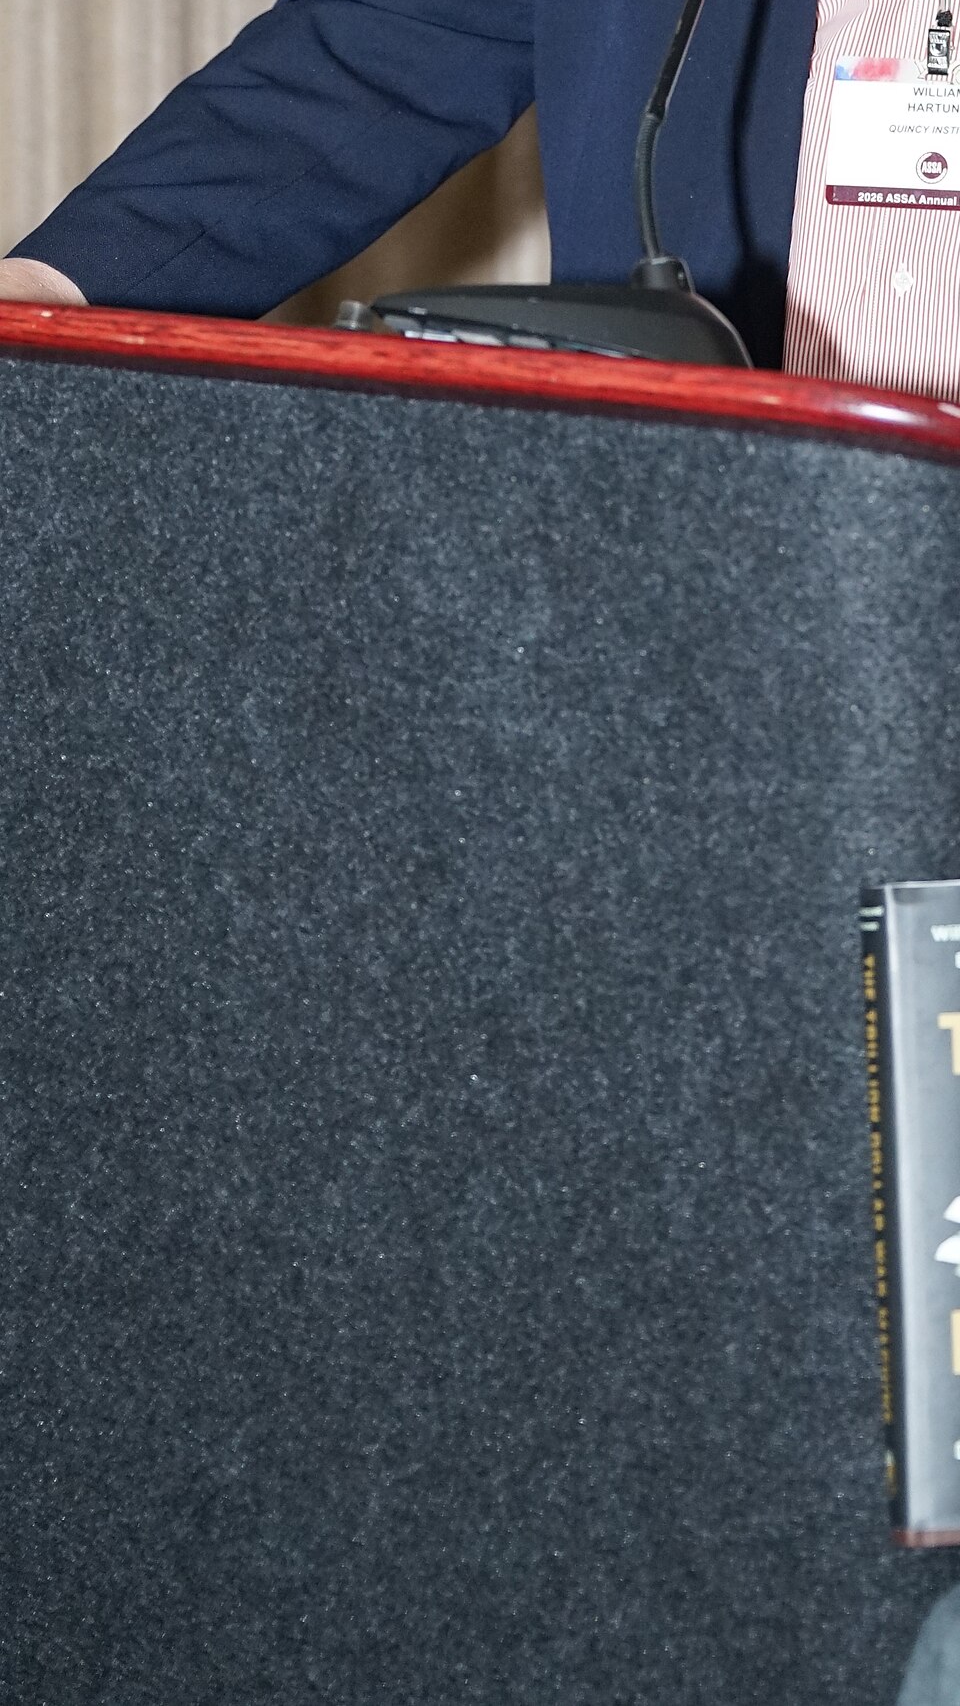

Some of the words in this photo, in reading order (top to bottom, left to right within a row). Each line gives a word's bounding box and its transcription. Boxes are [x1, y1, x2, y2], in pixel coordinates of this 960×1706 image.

[889, 125, 930, 134] QUINCY
[921, 161, 942, 174] ASSA
[858, 192, 883, 202] 2026
[886, 194, 916, 204] ASSA
[918, 196, 957, 207] Annual
